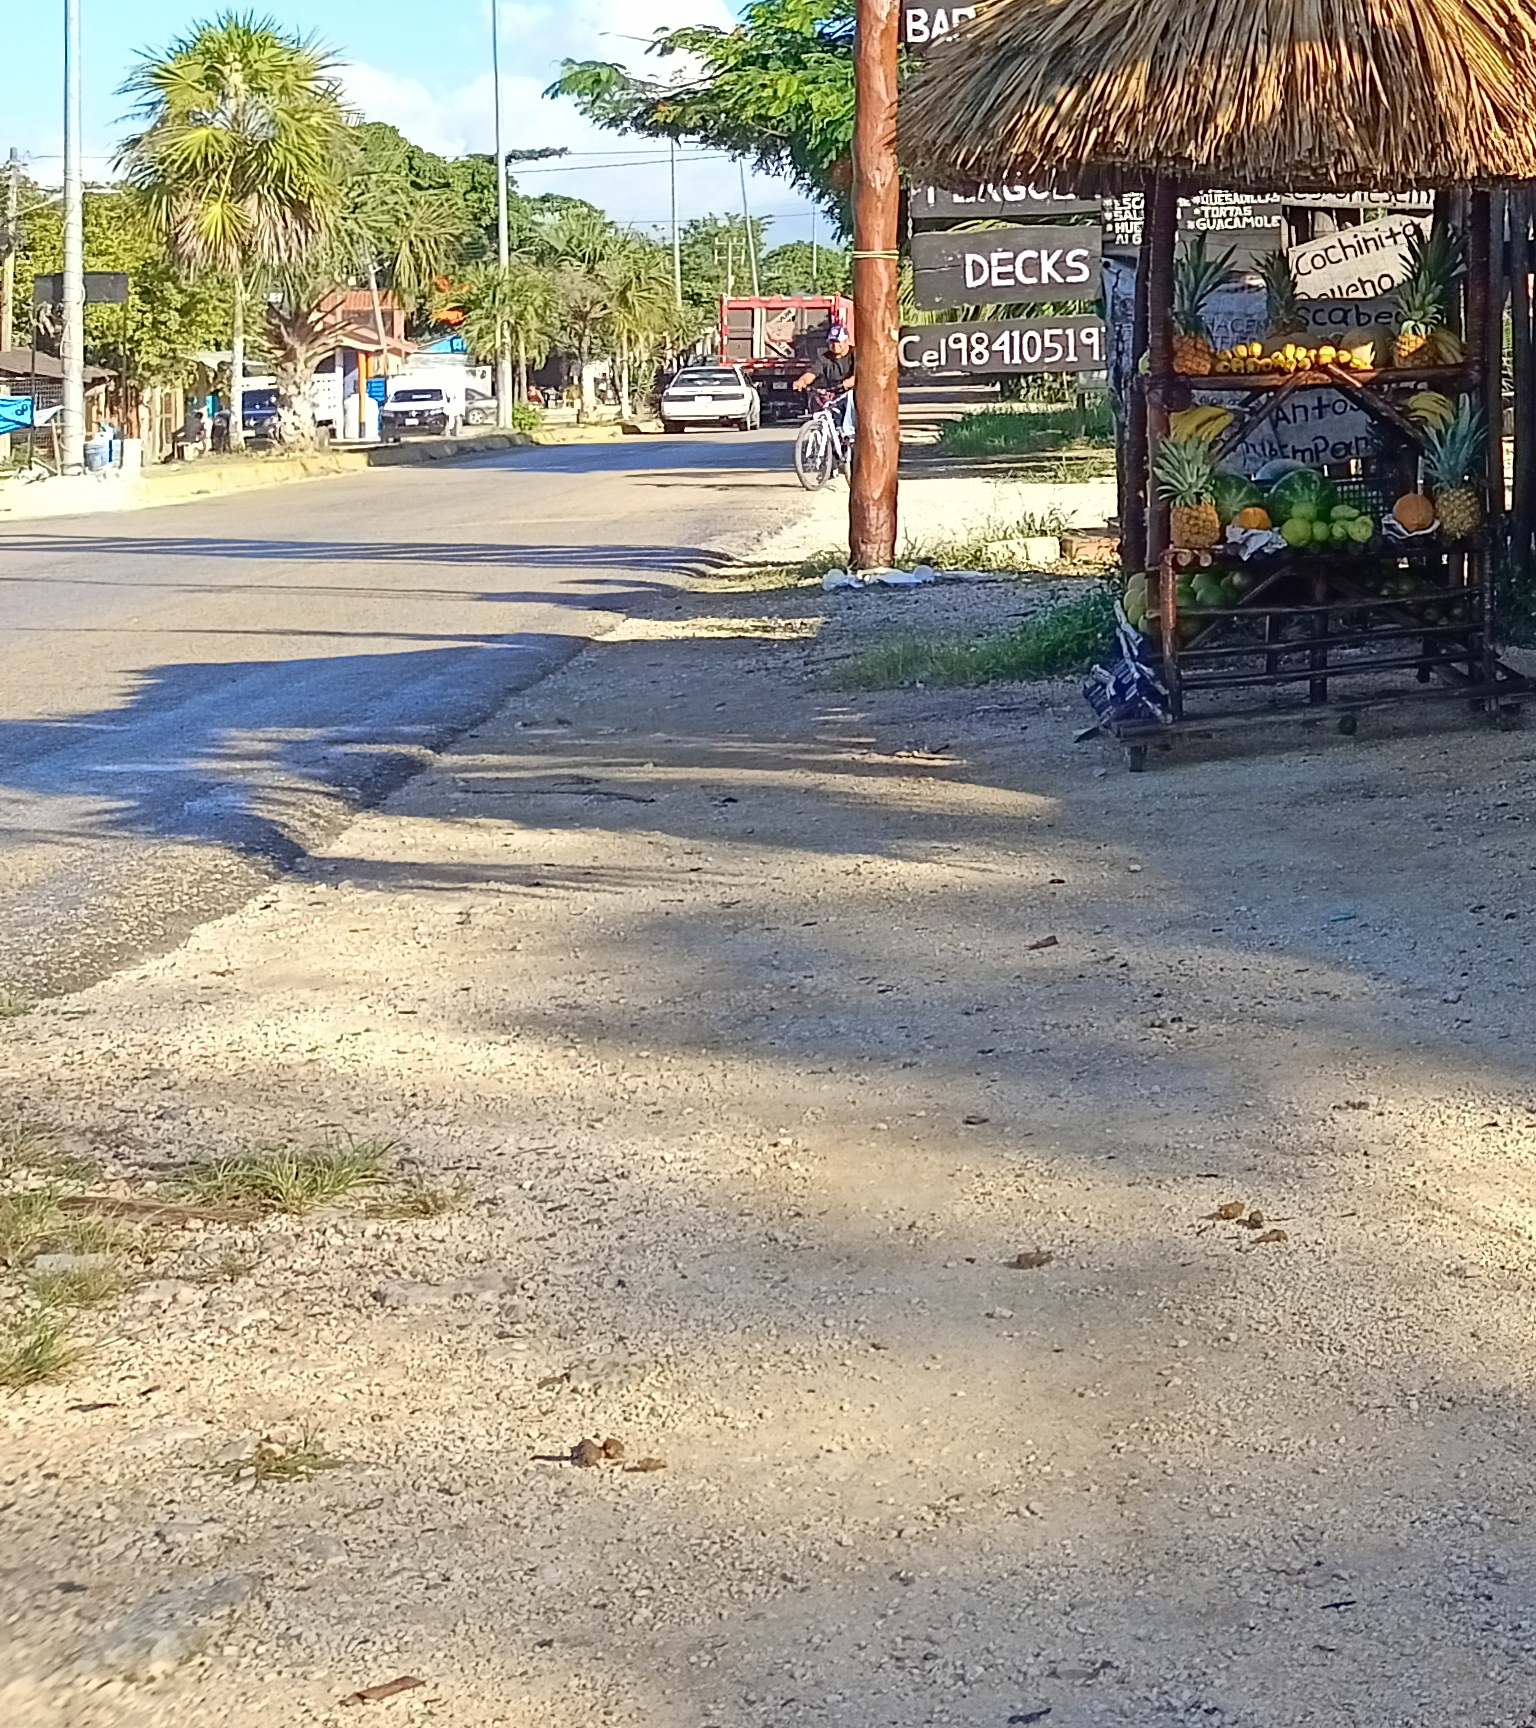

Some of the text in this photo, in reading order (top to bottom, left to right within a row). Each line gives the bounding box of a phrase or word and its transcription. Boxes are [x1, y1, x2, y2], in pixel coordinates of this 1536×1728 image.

[1200, 206, 1253, 219] TORTAS
[1195, 215, 1282, 231] GUACAMOLE
[965, 249, 1090, 288] DECKS
